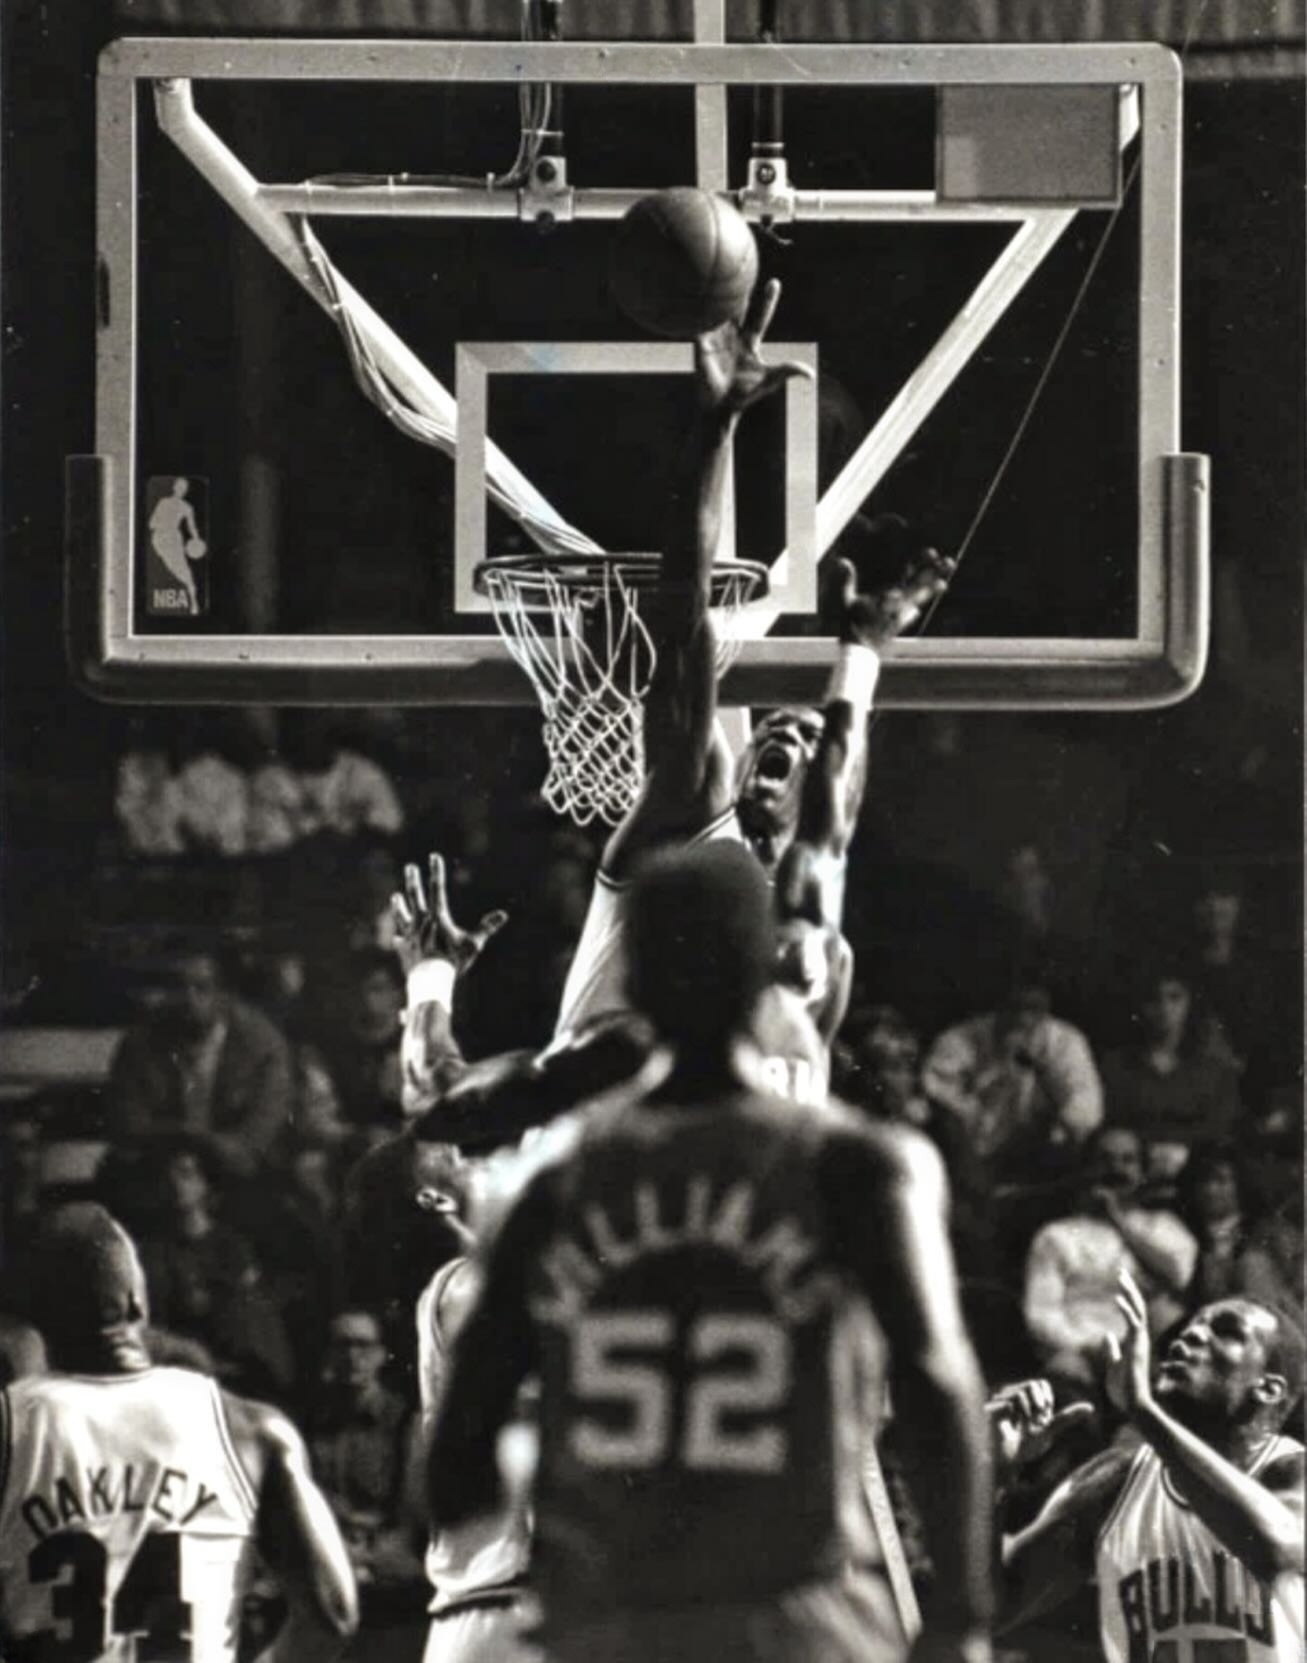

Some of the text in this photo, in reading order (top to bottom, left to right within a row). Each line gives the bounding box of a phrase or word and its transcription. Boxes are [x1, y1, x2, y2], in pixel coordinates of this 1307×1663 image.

[153, 589, 189, 609] NBA
[572, 1312, 792, 1472] 52
[22, 1464, 218, 1541] OAKLEY
[12, 1530, 192, 1663] 34
